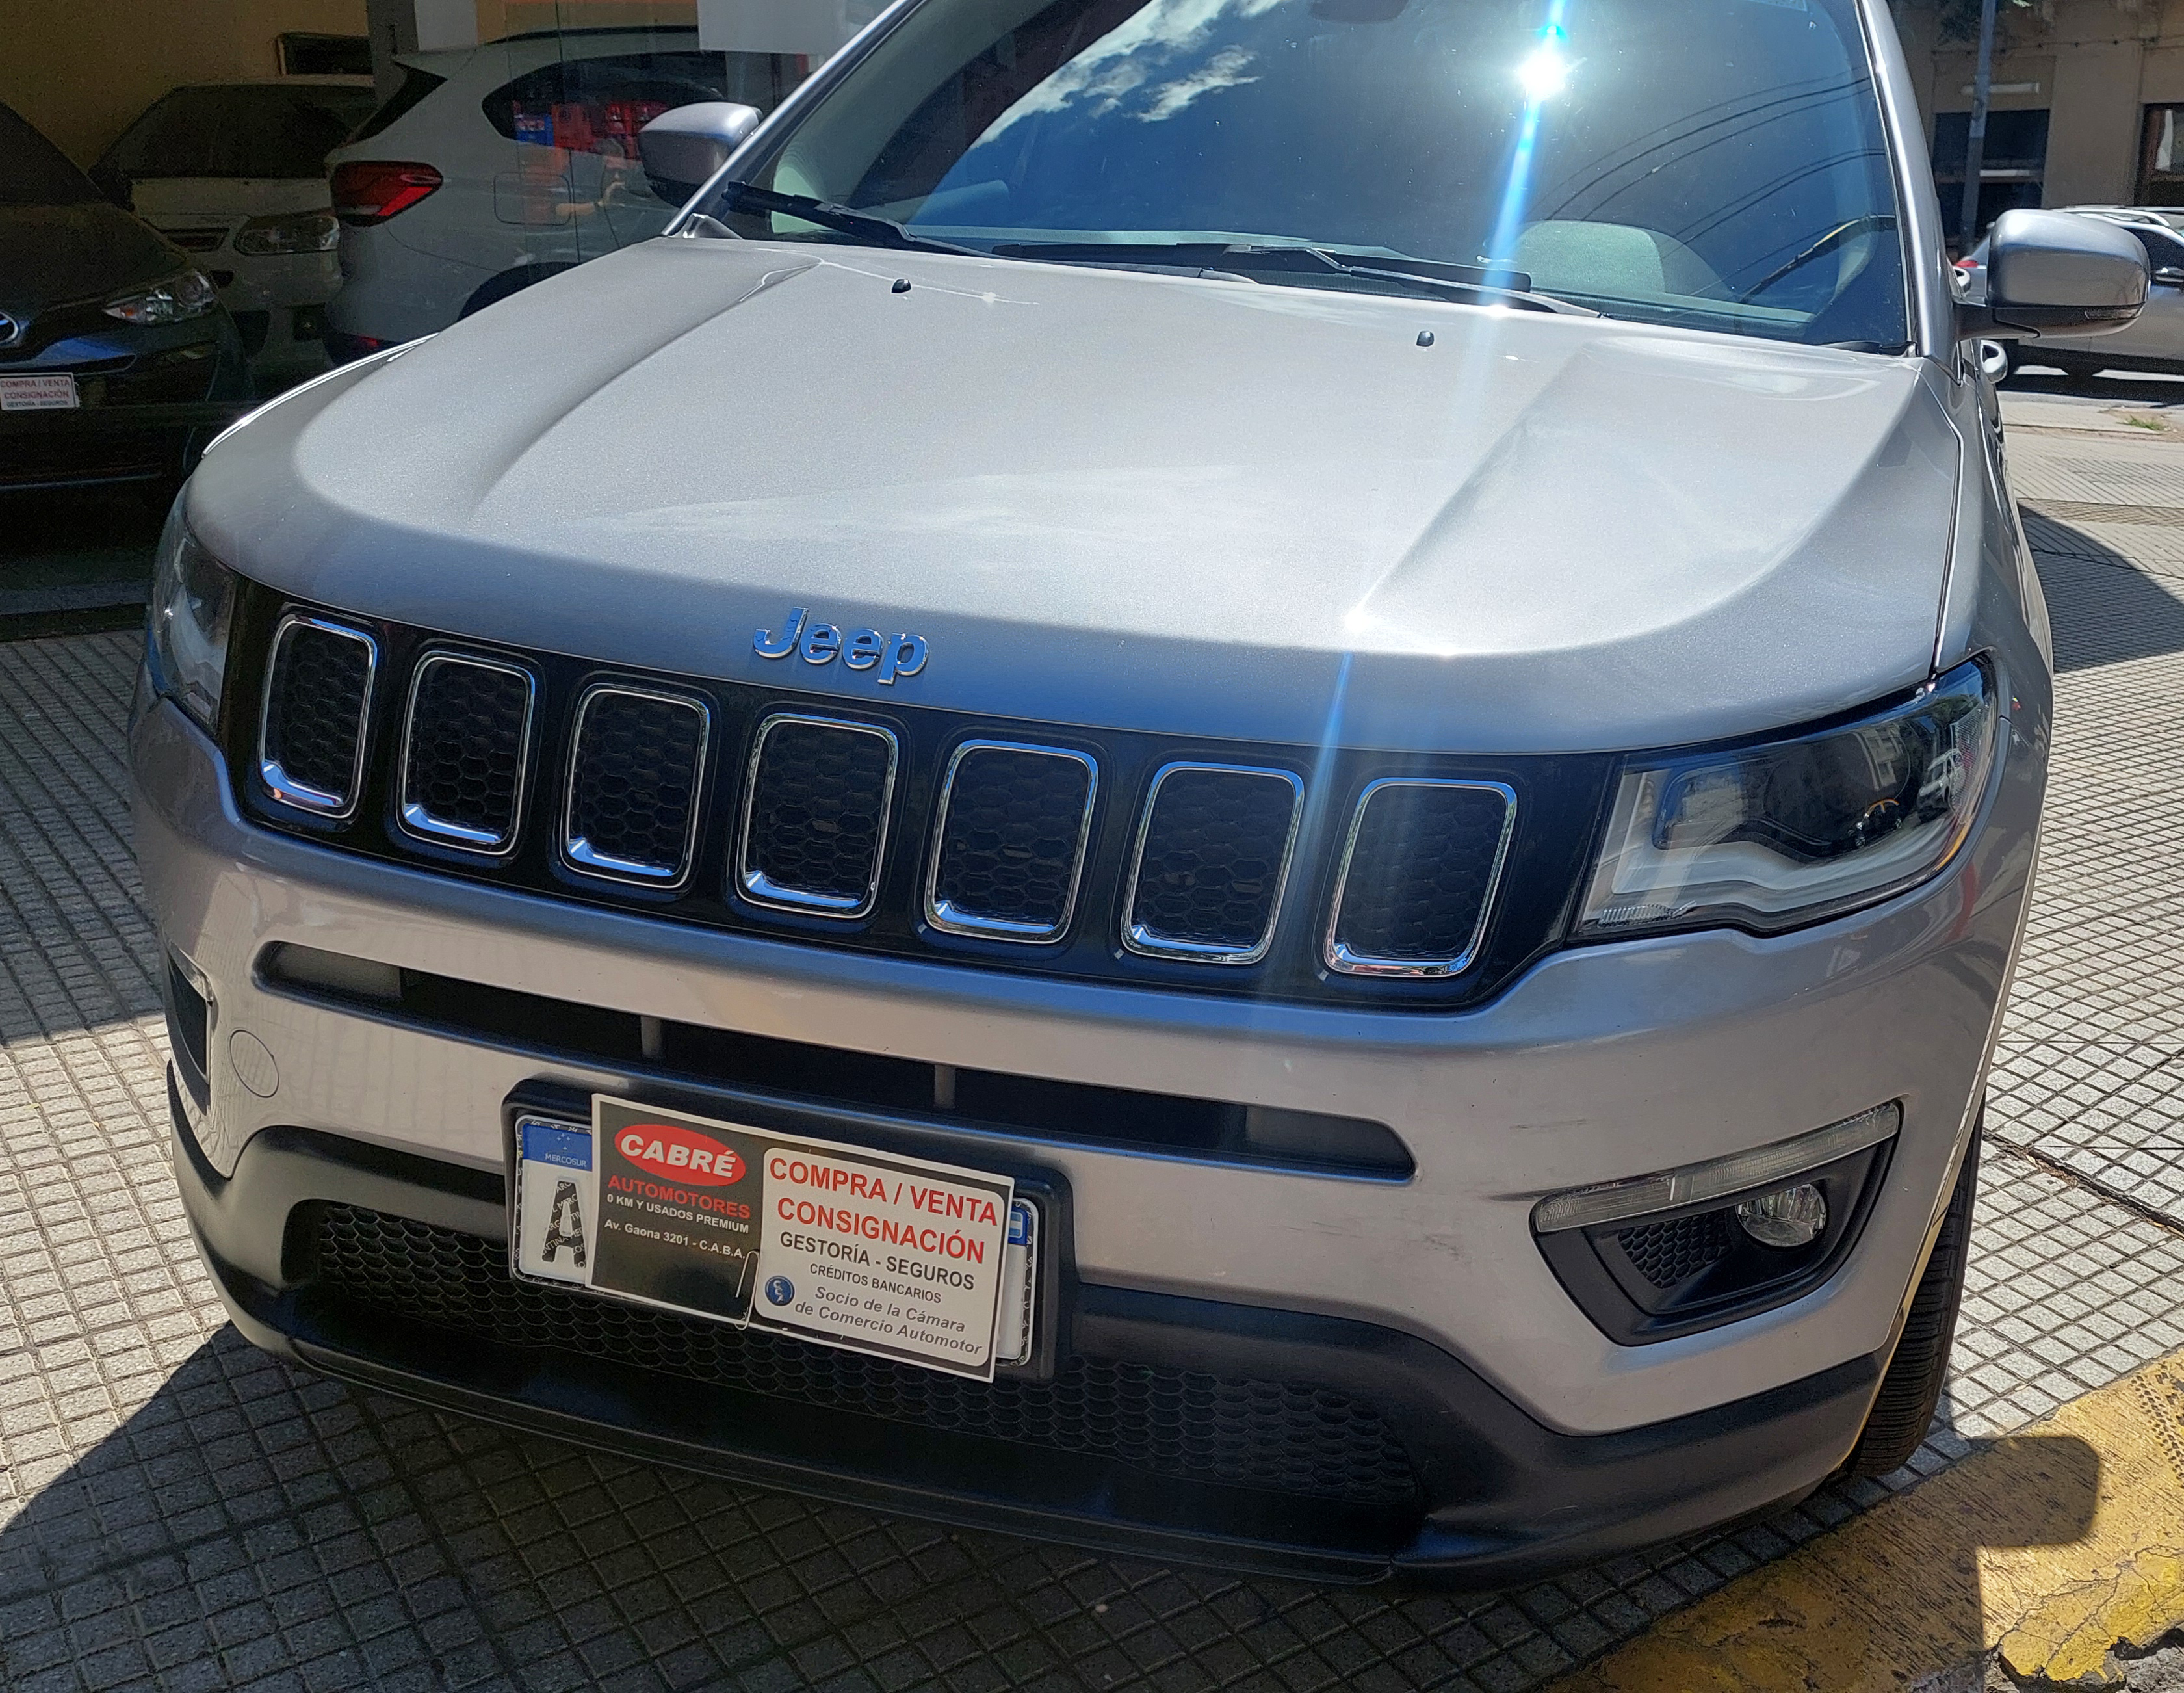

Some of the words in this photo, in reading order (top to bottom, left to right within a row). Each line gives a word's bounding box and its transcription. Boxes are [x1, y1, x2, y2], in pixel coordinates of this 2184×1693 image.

[42, 378, 70, 387] VENTA
[753, 607, 930, 685] Jeep
[545, 1153, 587, 1168] MERCOSUR
[621, 1135, 736, 1177] CABRÉ
[607, 1194, 614, 1203] 0
[616, 1196, 633, 1207] KM
[636, 1200, 644, 1209] Y
[646, 1203, 693, 1221] USADOS
[696, 1214, 749, 1234] PREMIUM
[608, 1175, 750, 1219] AUTOMOTORES
[770, 1157, 887, 1203] COMPRA
[893, 1183, 903, 1205] /
[910, 1185, 998, 1226] VENTA
[541, 1180, 587, 1268] A
[604, 1219, 621, 1231] Av.
[625, 1223, 660, 1240] Gaona
[663, 1232, 689, 1246] 3201
[699, 1240, 746, 1259] C.A.B.A.
[777, 1198, 985, 1264] CONSIGNACIÓN
[780, 1231, 870, 1266] GESTORÍA
[886, 1255, 975, 1291] SEGUROS
[810, 1263, 868, 1286] CRÉDITOS
[872, 1278, 942, 1304] BANCARIOS
[795, 1301, 814, 1315] de
[818, 1306, 894, 1333] Comercio
[896, 1324, 983, 1355] Automotor
[814, 1286, 859, 1307] Socio
[863, 1298, 883, 1313] de
[887, 1302, 901, 1317] la
[905, 1307, 966, 1333] Cámara
